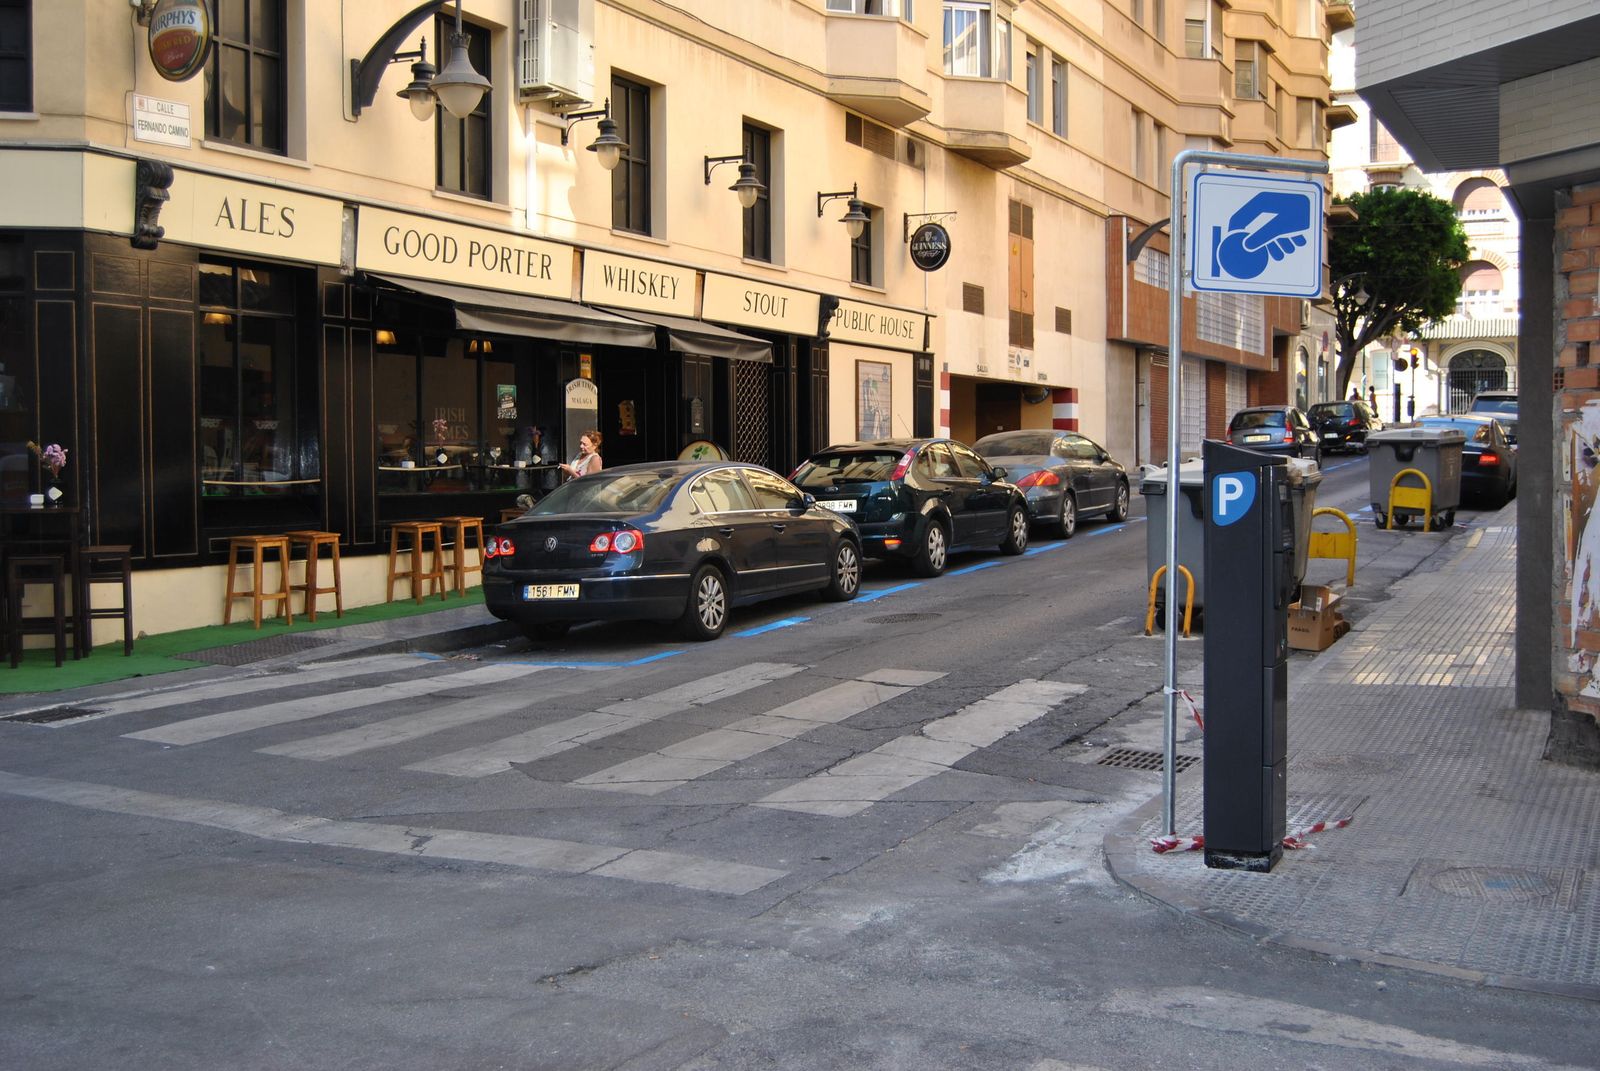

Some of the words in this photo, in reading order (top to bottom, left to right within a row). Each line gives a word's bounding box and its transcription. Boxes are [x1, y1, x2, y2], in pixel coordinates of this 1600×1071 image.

[156, 102, 174, 114] CALLE
[137, 119, 167, 134] FERNANDO
[168, 124, 188, 138] CAMINO
[215, 195, 295, 238] ALES
[384, 226, 458, 263] GOOD
[468, 240, 552, 280] PORTER
[603, 264, 680, 300] WHISKEY
[743, 290, 788, 318] STOUT
[835, 307, 875, 333] PUBLIC
[880, 315, 915, 340] HOUSE
[566, 380, 581, 394] IRISH
[582, 380, 597, 395] TIMES
[435, 407, 465, 422] IRISH
[1219, 477, 1243, 515] P
[532, 586, 553, 597] 1561
